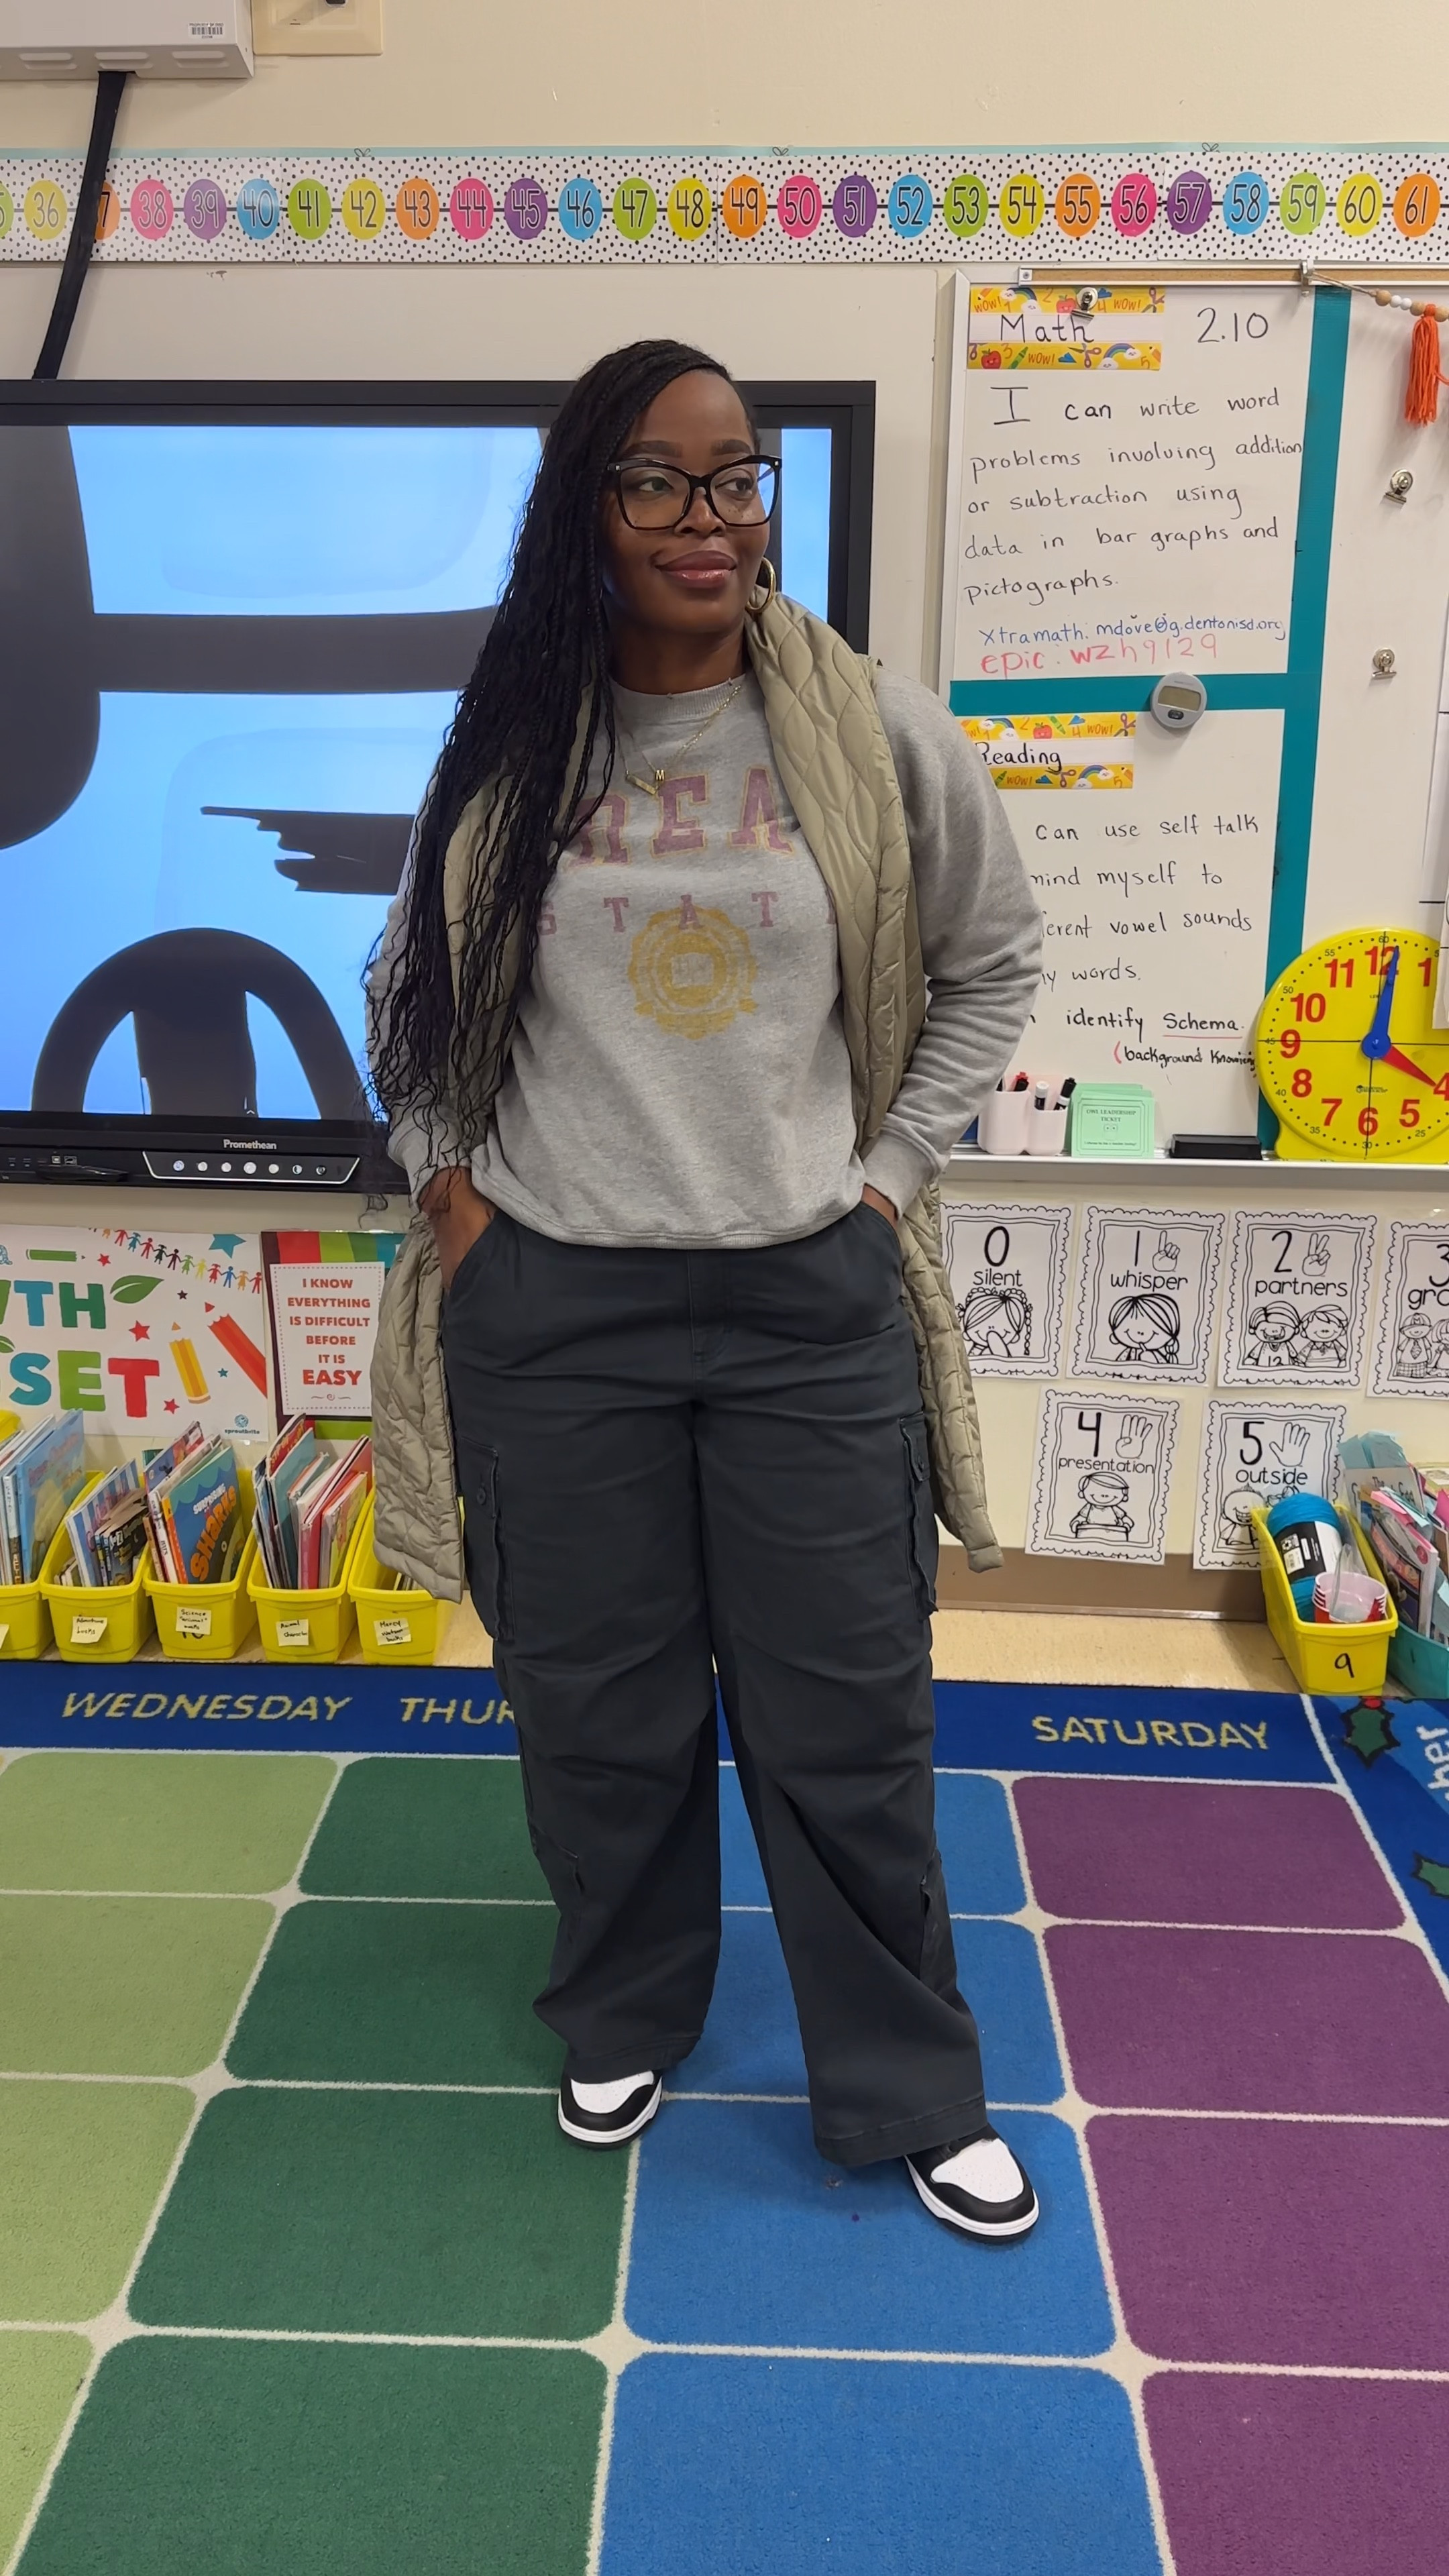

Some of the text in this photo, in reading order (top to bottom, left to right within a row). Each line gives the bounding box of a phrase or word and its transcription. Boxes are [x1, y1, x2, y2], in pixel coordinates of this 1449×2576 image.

[34, 191, 58, 228] 36
[99, 191, 111, 228] 7
[139, 190, 166, 228] 38
[192, 189, 219, 228] 39
[244, 190, 275, 228] 40
[298, 190, 320, 227] 41
[351, 190, 377, 227] 42
[404, 189, 431, 227] 43
[458, 189, 487, 227] 44
[512, 189, 541, 227] 45
[567, 189, 594, 227] 46
[622, 189, 648, 227] 47
[676, 189, 704, 227] 48
[731, 187, 759, 225] 49
[784, 186, 815, 225] 50
[844, 186, 865, 225] 51
[896, 186, 924, 225] 52
[952, 186, 979, 225] 53
[1008, 186, 1036, 225] 54
[1063, 185, 1093, 225] 55
[1120, 184, 1148, 224] 56
[1175, 184, 1205, 223] 57
[1231, 184, 1261, 223] 58
[1289, 184, 1318, 223] 59
[1344, 185, 1377, 224] 60
[1405, 185, 1429, 225] 61
[1114, 299, 1140, 311] WOW!
[1000, 313, 1094, 343] Math
[1197, 307, 1269, 343] 2.10
[1028, 353, 1055, 366] WOW!
[990, 386, 1280, 425] I can write word
[971, 434, 1303, 484] problems involving addition
[967, 485, 1242, 519] or subtraction using
[965, 516, 1279, 559] data in bar graphs and
[963, 569, 1118, 606] pictographs.
[1087, 724, 1113, 735] WOW!
[975, 741, 1062, 772] Reading
[655, 769, 665, 780] M
[1006, 775, 1032, 786] WOW!
[1036, 814, 1259, 841] can use self talk
[1097, 861, 1177, 898] myself
[1201, 863, 1223, 885] to
[537, 890, 837, 936] STAT
[1110, 912, 1167, 935] vowel
[1183, 909, 1252, 932] sounds
[1324, 949, 1335, 957] 55
[1072, 957, 1142, 981] words.
[1324, 958, 1354, 988] 11
[1417, 957, 1432, 987] 1
[1283, 985, 1293, 994] 50
[1290, 992, 1326, 1023] 10
[1066, 1007, 1144, 1043] identify
[1281, 1028, 1301, 1059] 9
[1275, 1089, 1287, 1097] 40
[1291, 1069, 1312, 1098] 8
[1321, 1097, 1343, 1127] 7
[1358, 1107, 1379, 1136] 6
[1399, 1099, 1421, 1128] 5
[223, 1138, 277, 1150] Promethean
[1309, 1126, 1321, 1134] 35
[1415, 1129, 1426, 1138] 25
[1362, 1141, 1373, 1149] 30
[984, 1226, 1010, 1267] 0
[1134, 1230, 1140, 1267] 1
[1272, 1230, 1292, 1273] 2
[303, 1279, 353, 1289] I KNOW
[973, 1268, 1023, 1287] silent
[1110, 1270, 1188, 1292] whisper
[1254, 1277, 1348, 1297] partners
[287, 1297, 371, 1308] EVERYTHING
[289, 1316, 370, 1327] IS DIFFICULT
[306, 1336, 356, 1345] BEFORE
[319, 1354, 345, 1364] IT IS
[9, 1350, 160, 1417] SET
[303, 1369, 362, 1386] EASY
[1077, 1411, 1102, 1458] 4
[1239, 1421, 1265, 1465] 5
[1058, 1455, 1155, 1474] presentation
[1235, 1467, 1308, 1486] outside
[1334, 1653, 1355, 1679] 9
[62, 1692, 352, 1720] WEDNESDAY
[1032, 1716, 1268, 1750] SATURDAY
